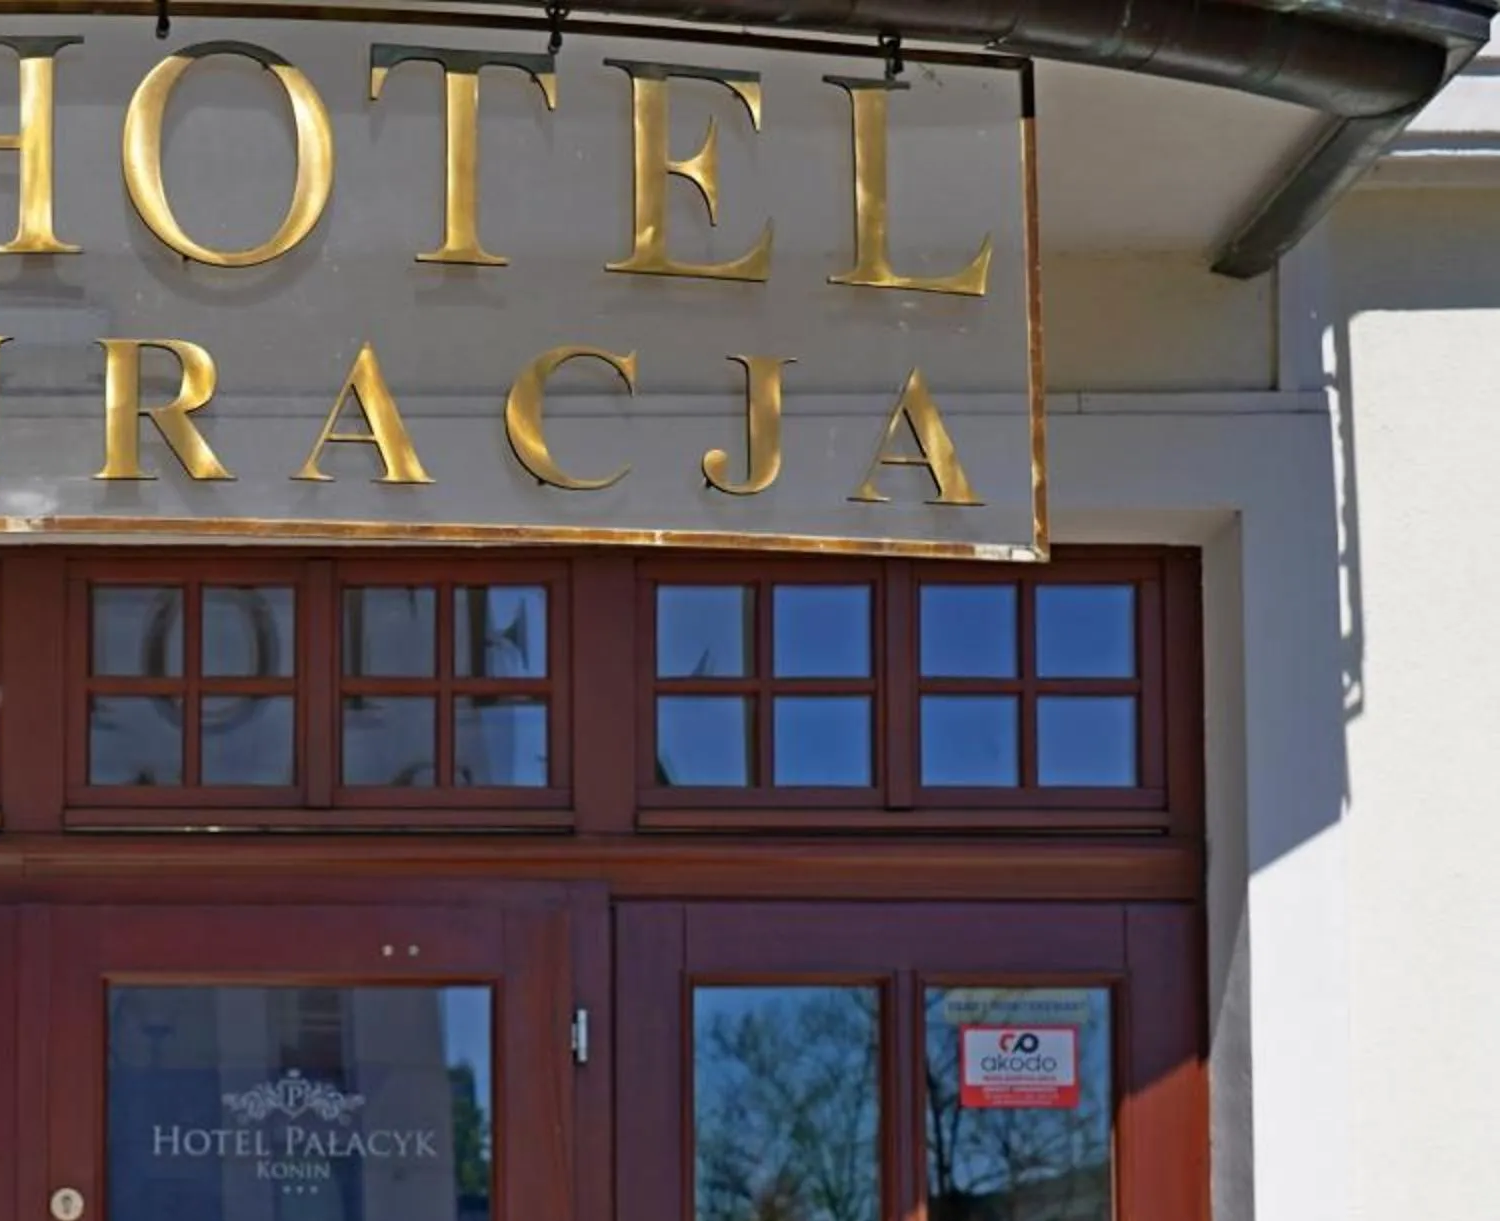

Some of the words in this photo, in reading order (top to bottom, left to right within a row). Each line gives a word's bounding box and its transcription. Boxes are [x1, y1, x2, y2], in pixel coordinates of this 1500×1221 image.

[980, 1054, 1057, 1072] akodo
[152, 1125, 270, 1156] HOTEL
[285, 1125, 438, 1157] PAŁACYK
[256, 1161, 331, 1180] KONIN
